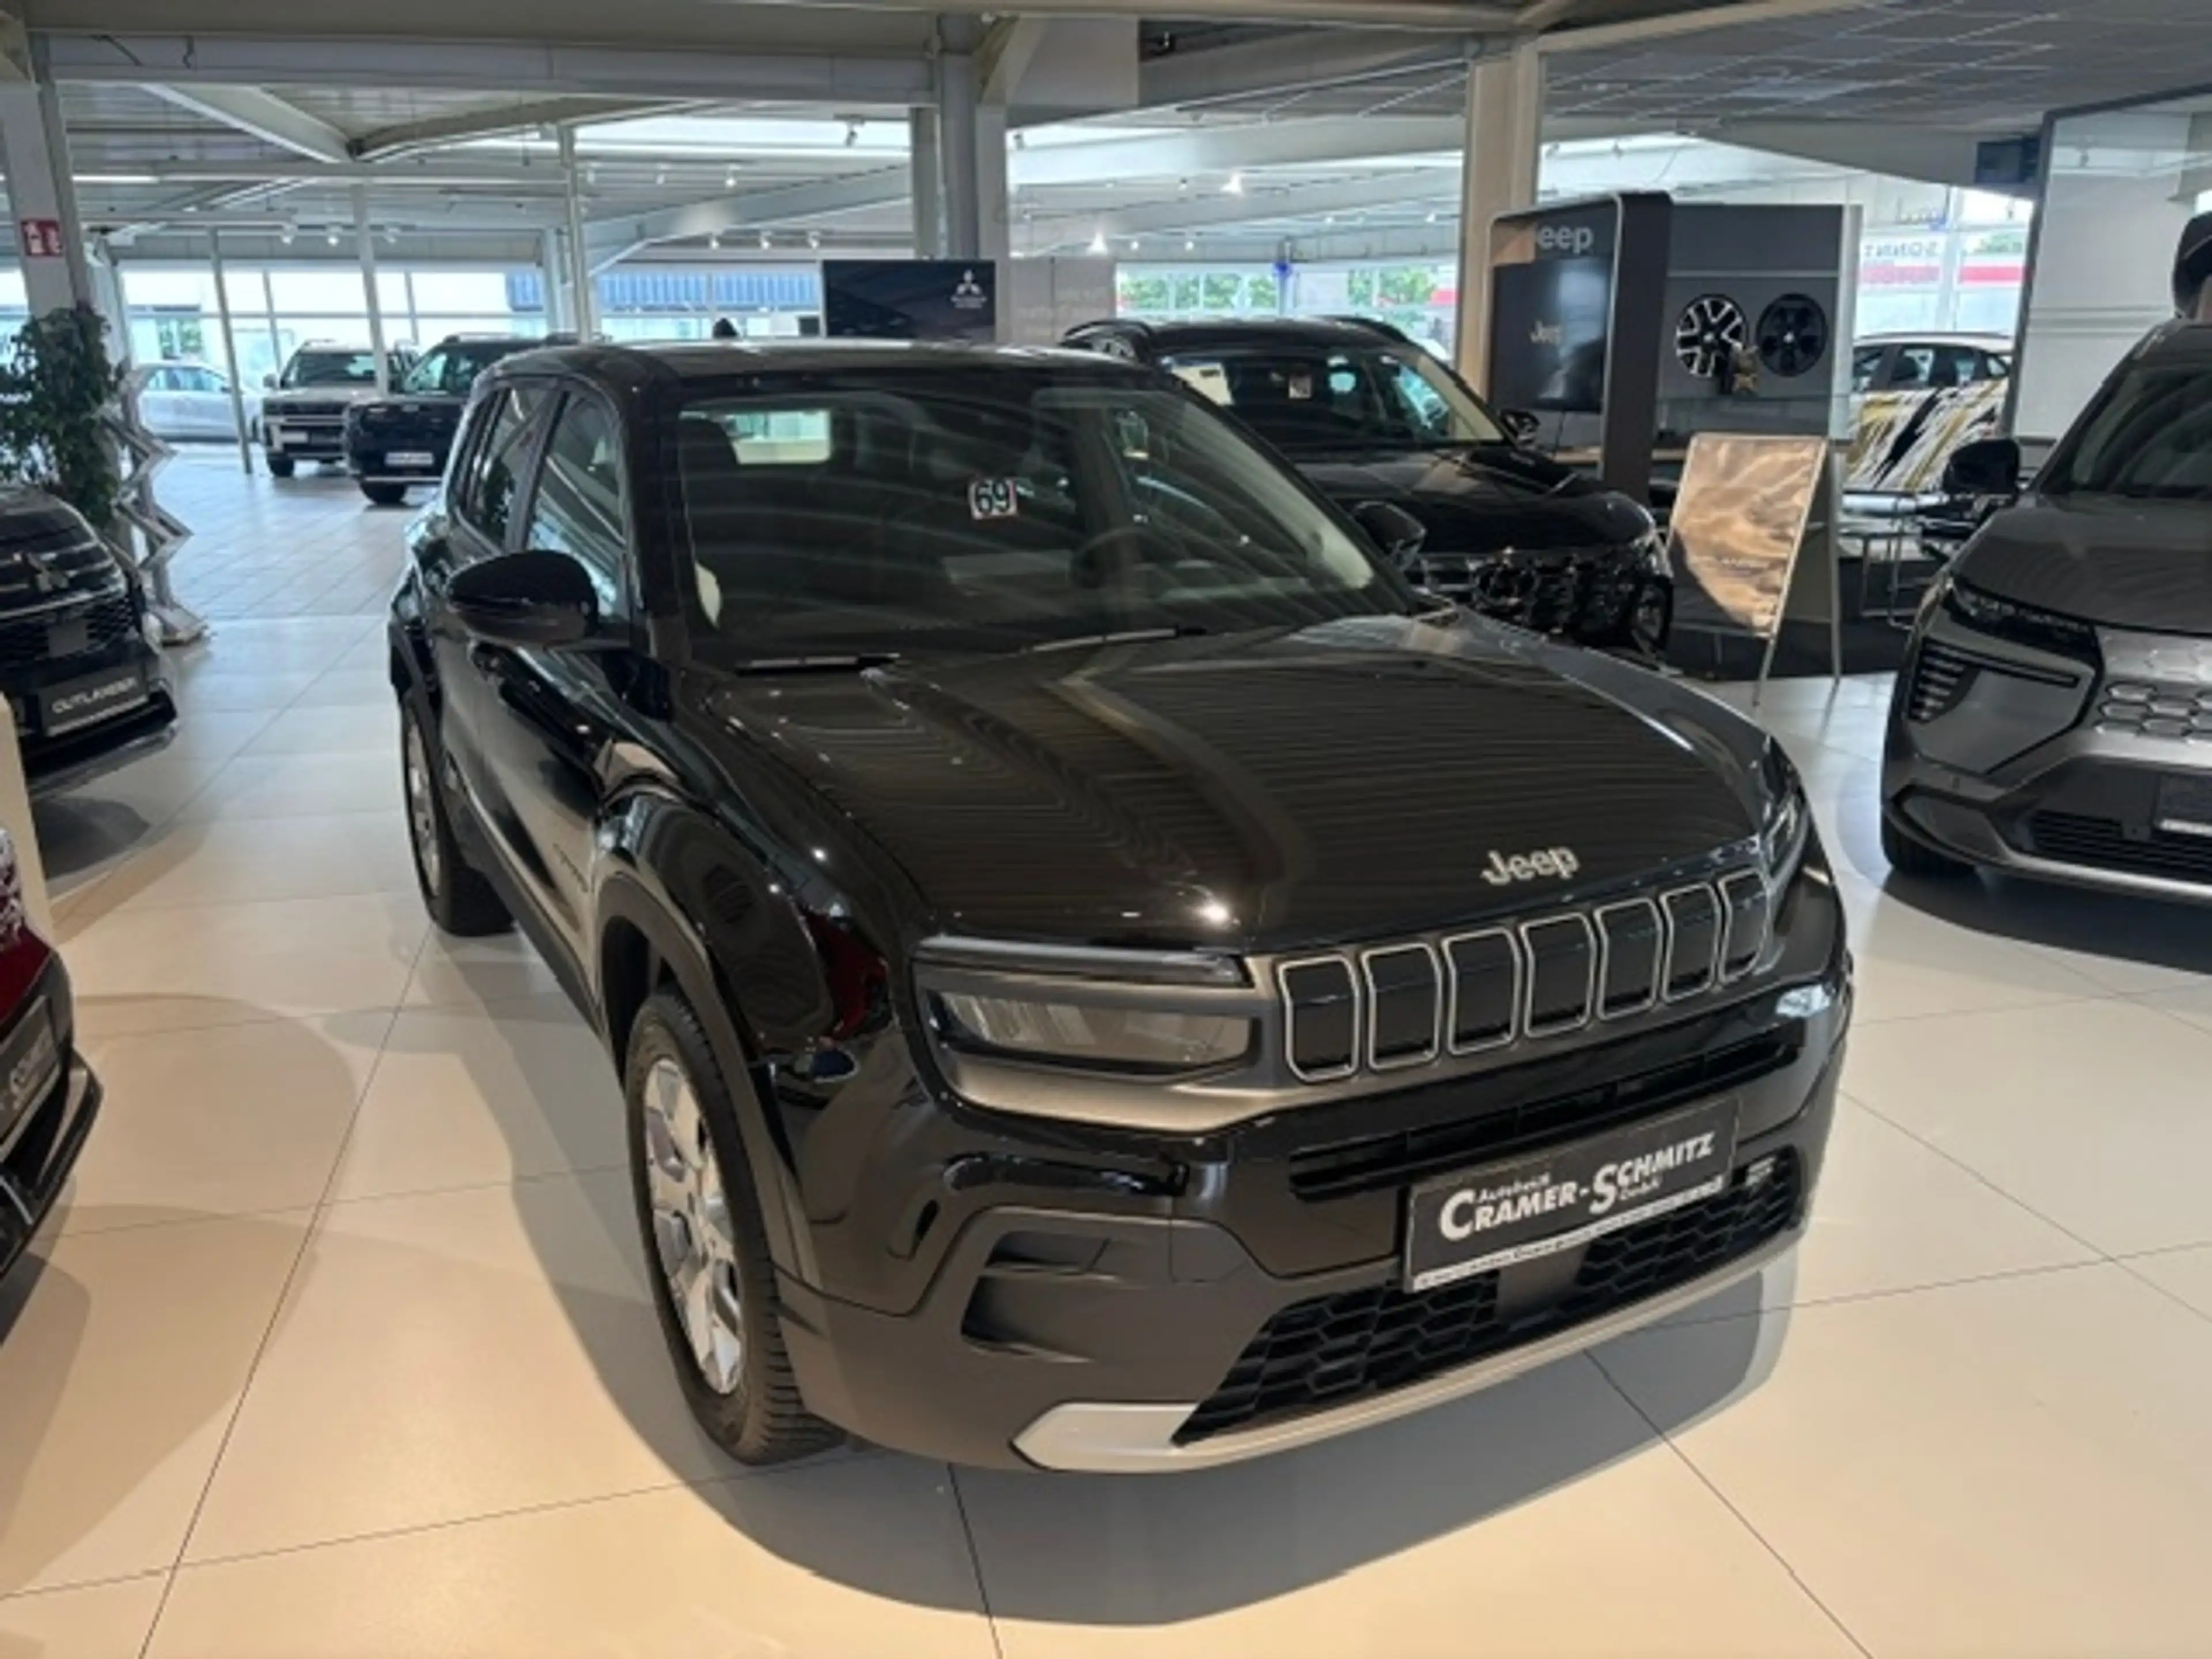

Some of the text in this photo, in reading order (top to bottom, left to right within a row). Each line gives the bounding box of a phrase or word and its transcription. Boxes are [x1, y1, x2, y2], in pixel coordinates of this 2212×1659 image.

[1536, 226, 1593, 254] eep
[974, 481, 1010, 514] 69
[1480, 846, 1580, 886] Jeep
